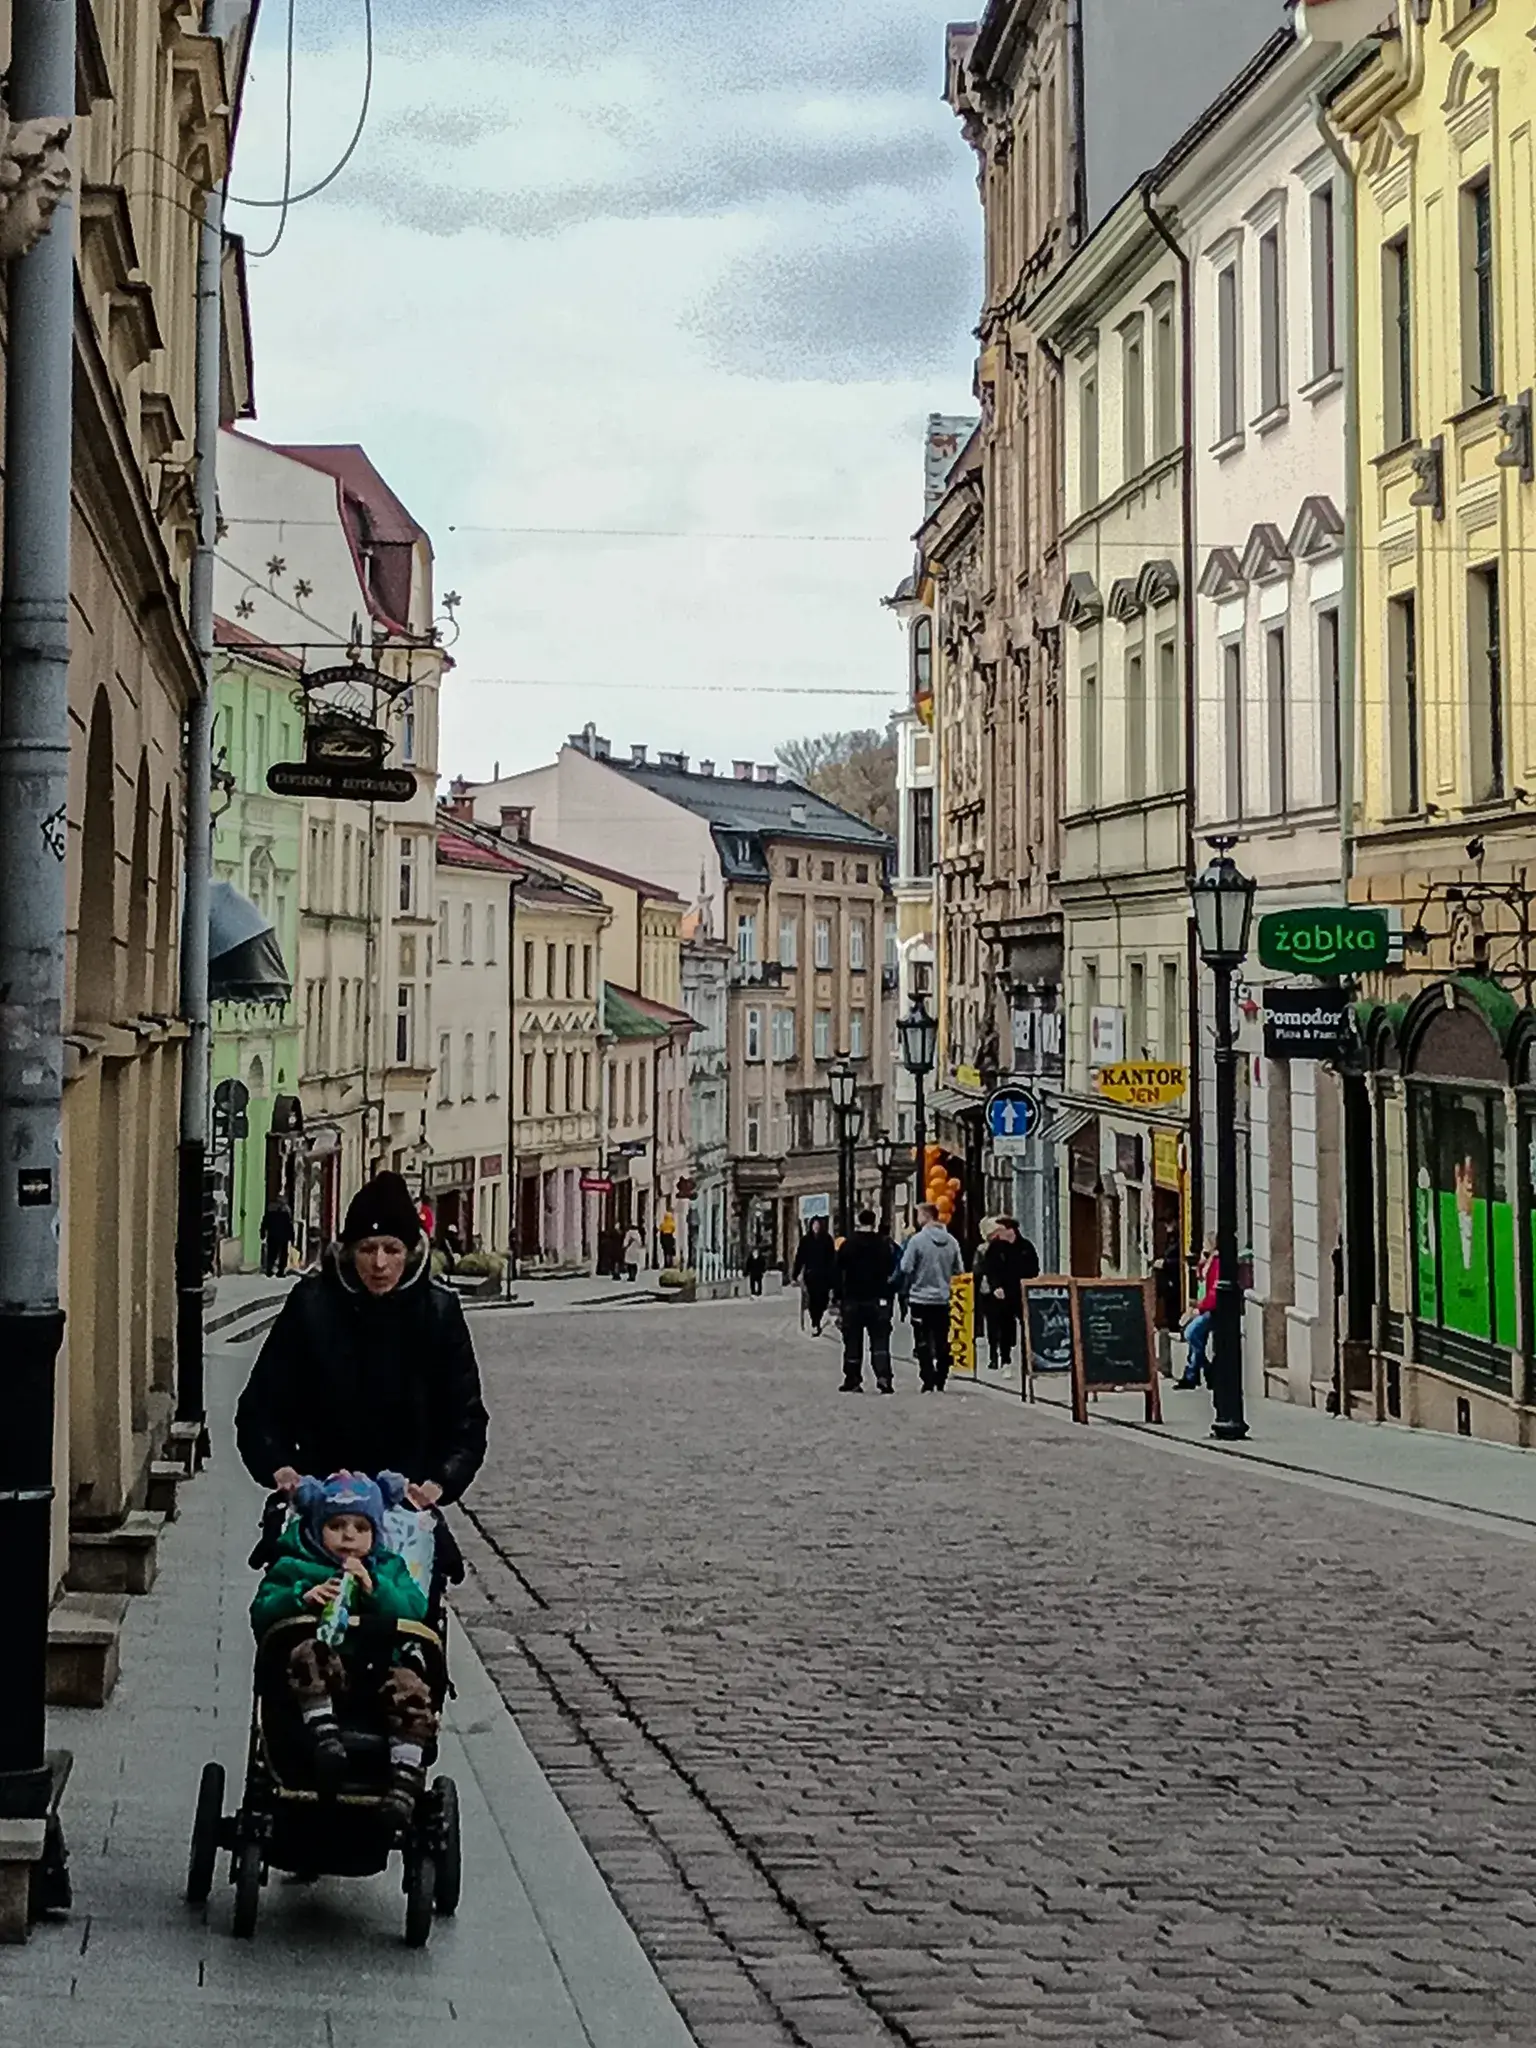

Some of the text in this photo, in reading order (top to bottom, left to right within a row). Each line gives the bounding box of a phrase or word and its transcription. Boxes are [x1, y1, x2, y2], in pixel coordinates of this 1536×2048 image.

[1275, 924, 1376, 951] żabka
[1101, 1068, 1183, 1087] KANTOR
[1127, 1087, 1160, 1104] JEN
